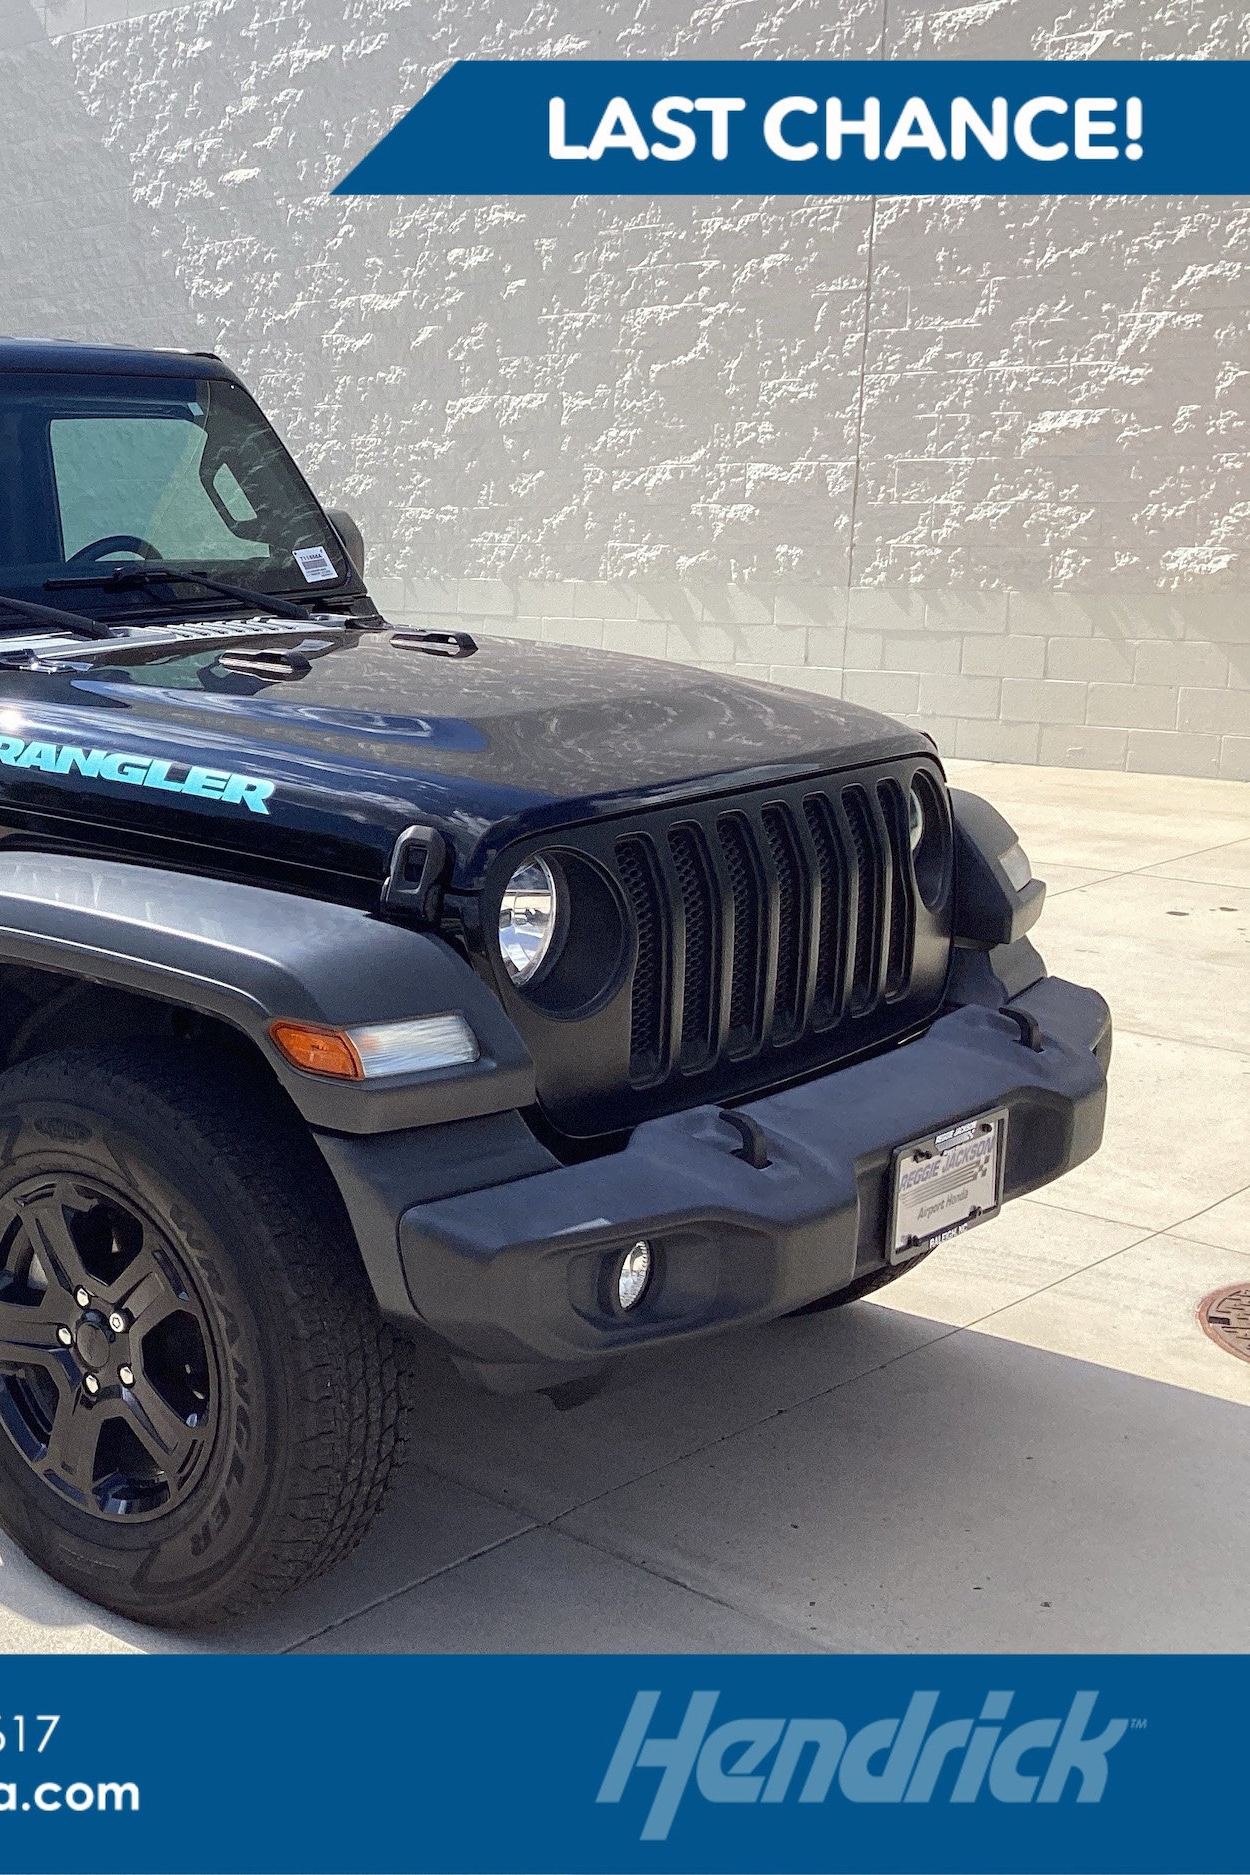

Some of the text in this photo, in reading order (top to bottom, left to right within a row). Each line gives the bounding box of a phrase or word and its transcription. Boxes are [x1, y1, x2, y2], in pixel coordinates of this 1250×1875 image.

[899, 1136, 995, 1190] REGGIE JACKSON
[917, 1187, 969, 1220] Airport Honda
